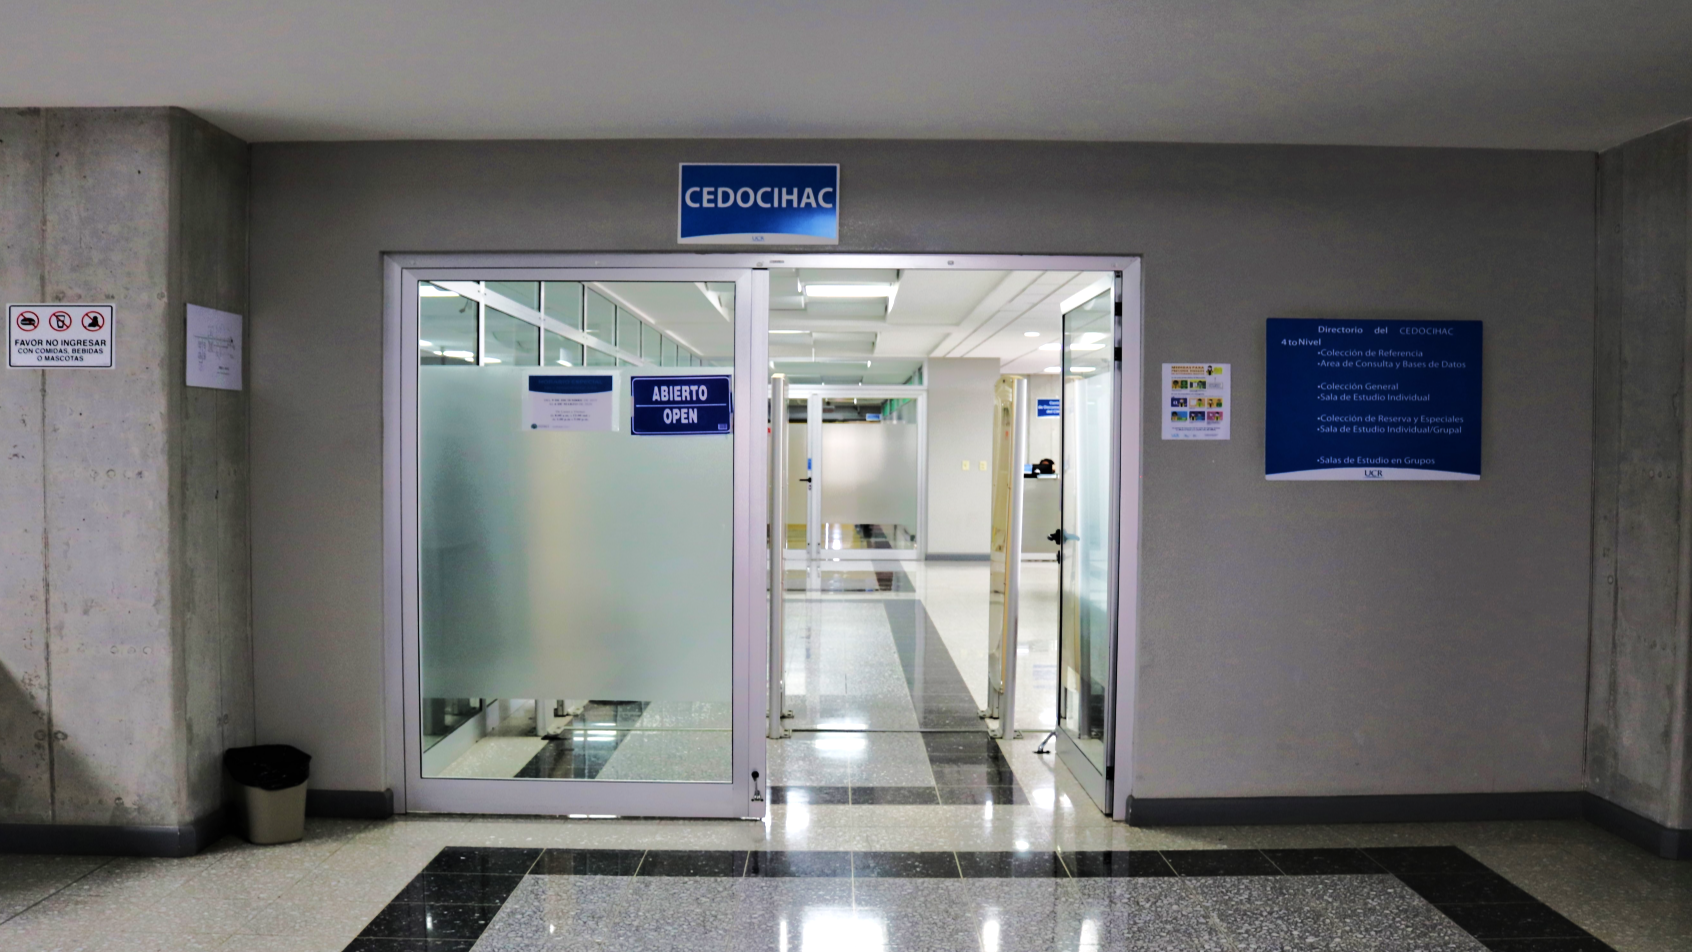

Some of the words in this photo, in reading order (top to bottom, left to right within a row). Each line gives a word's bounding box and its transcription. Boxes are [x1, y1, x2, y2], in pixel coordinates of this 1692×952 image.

[685, 187, 833, 208] CEDOCIHAC
[1318, 326, 1363, 334] Directorio
[1342, 360, 1353, 368] de
[652, 385, 708, 402] ABIERTO
[663, 408, 698, 424] OPEN
[1420, 416, 1464, 424] Especiales
[1387, 426, 1462, 435] Individual/Grupal
[1404, 457, 1435, 466] Grupos
